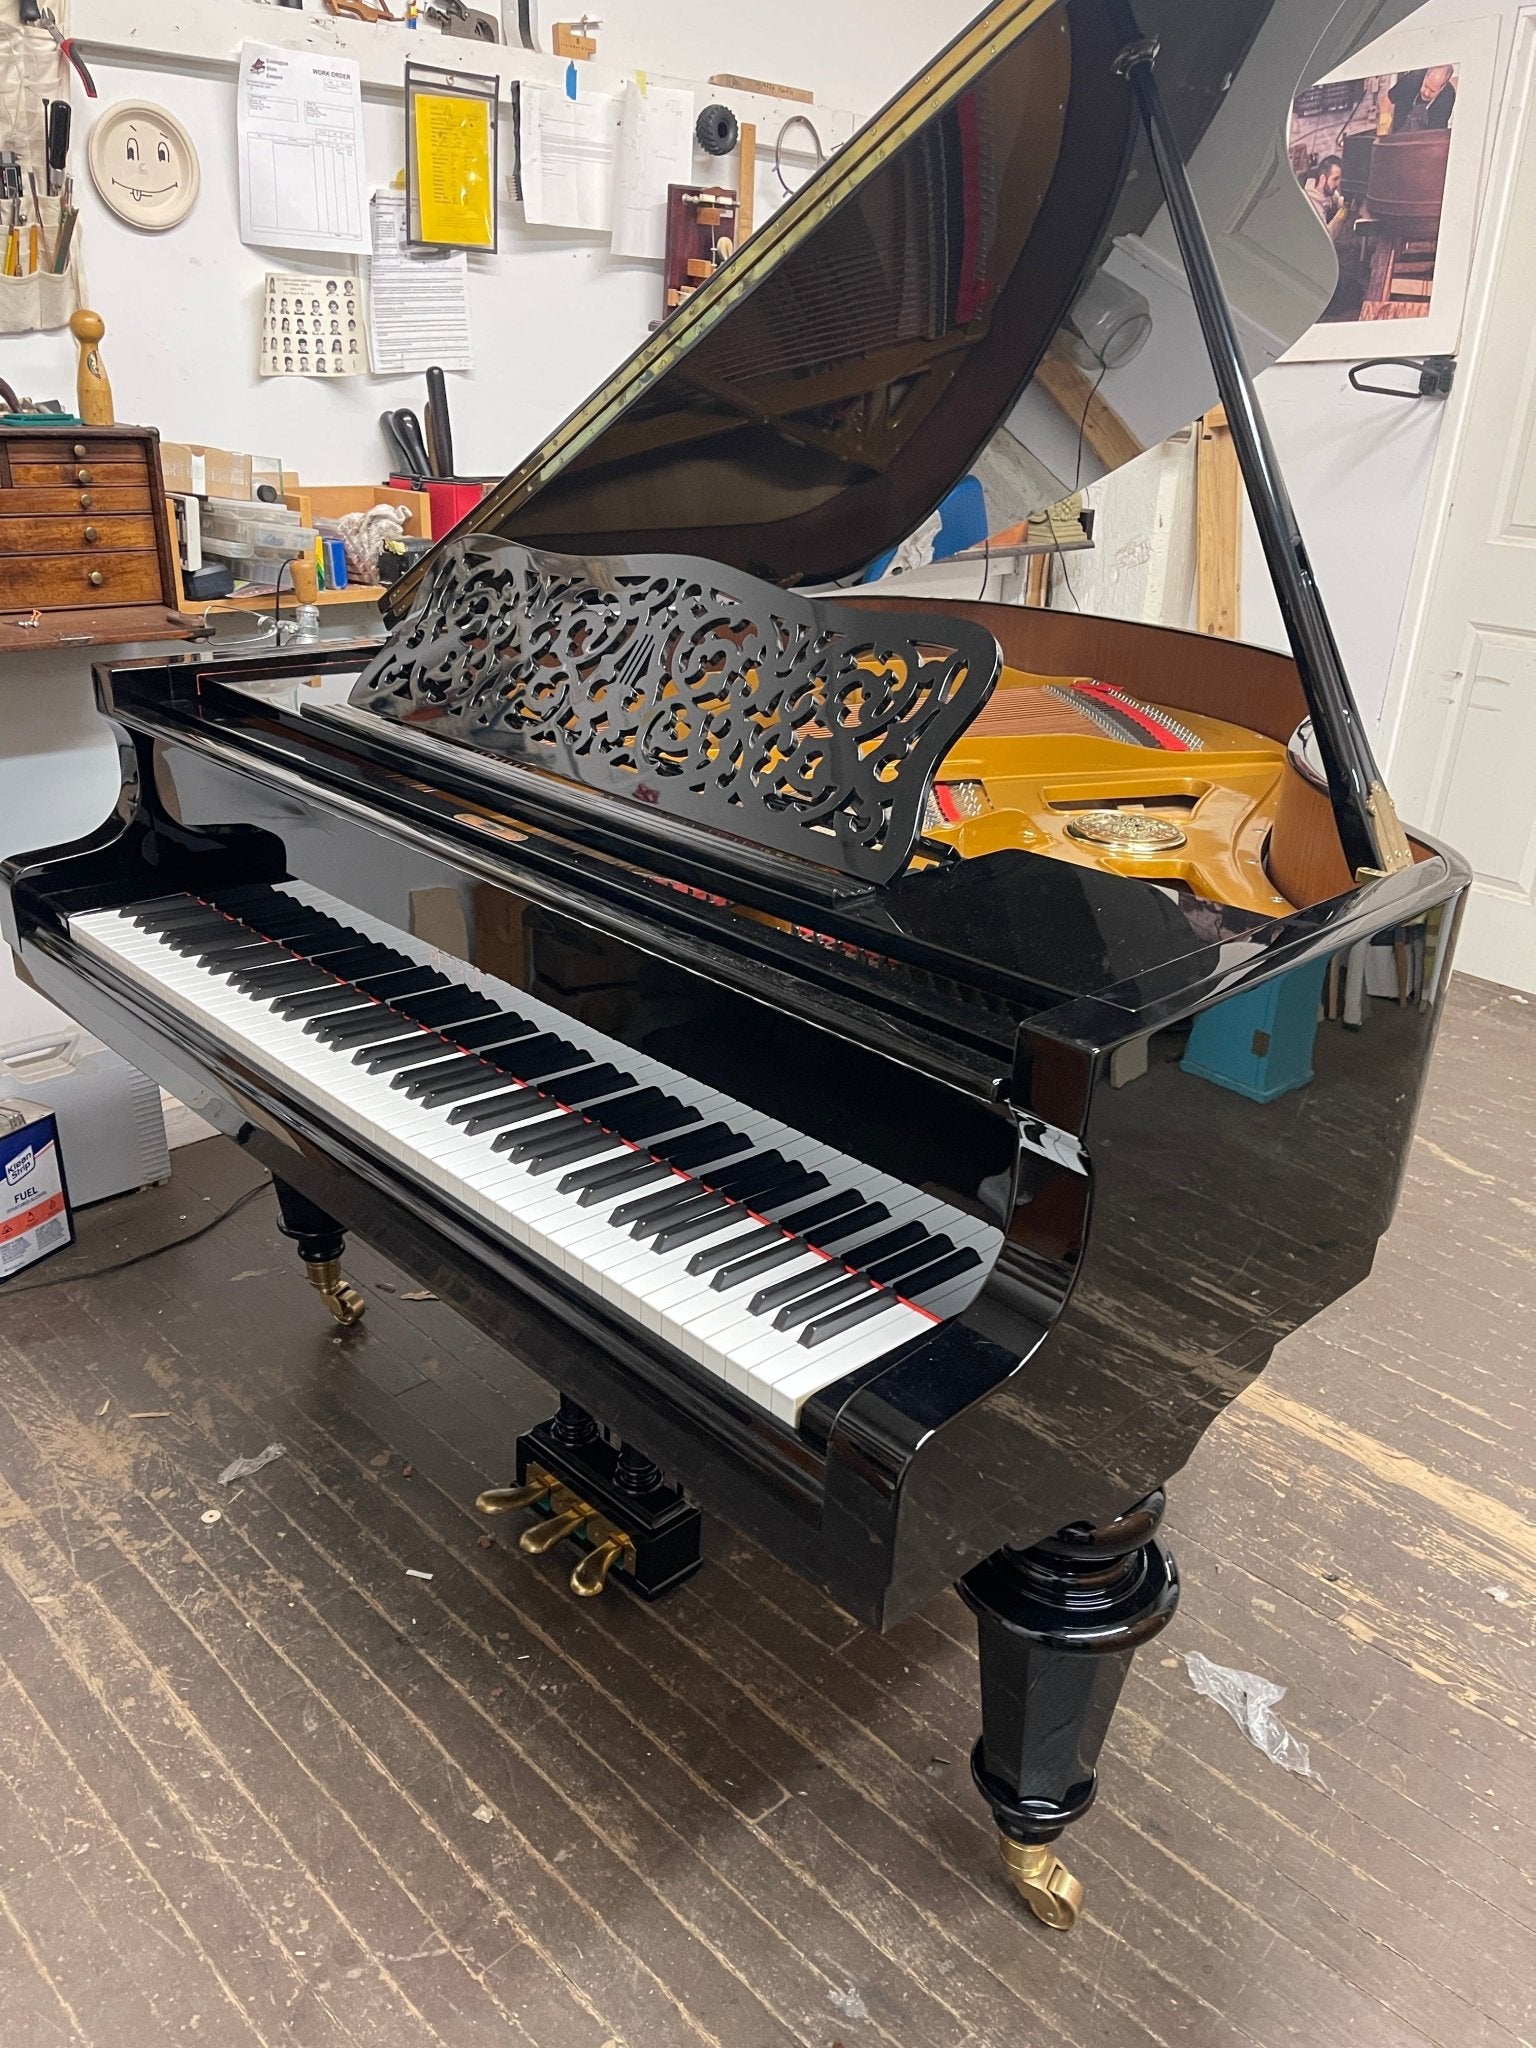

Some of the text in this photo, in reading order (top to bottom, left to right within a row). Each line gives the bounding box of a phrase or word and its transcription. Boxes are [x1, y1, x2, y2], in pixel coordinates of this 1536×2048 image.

[312, 68, 351, 80] WORK ORDER
[7, 1152, 32, 1174] Klean
[11, 1161, 31, 1180] Strip
[14, 1186, 39, 1204] FUEL
